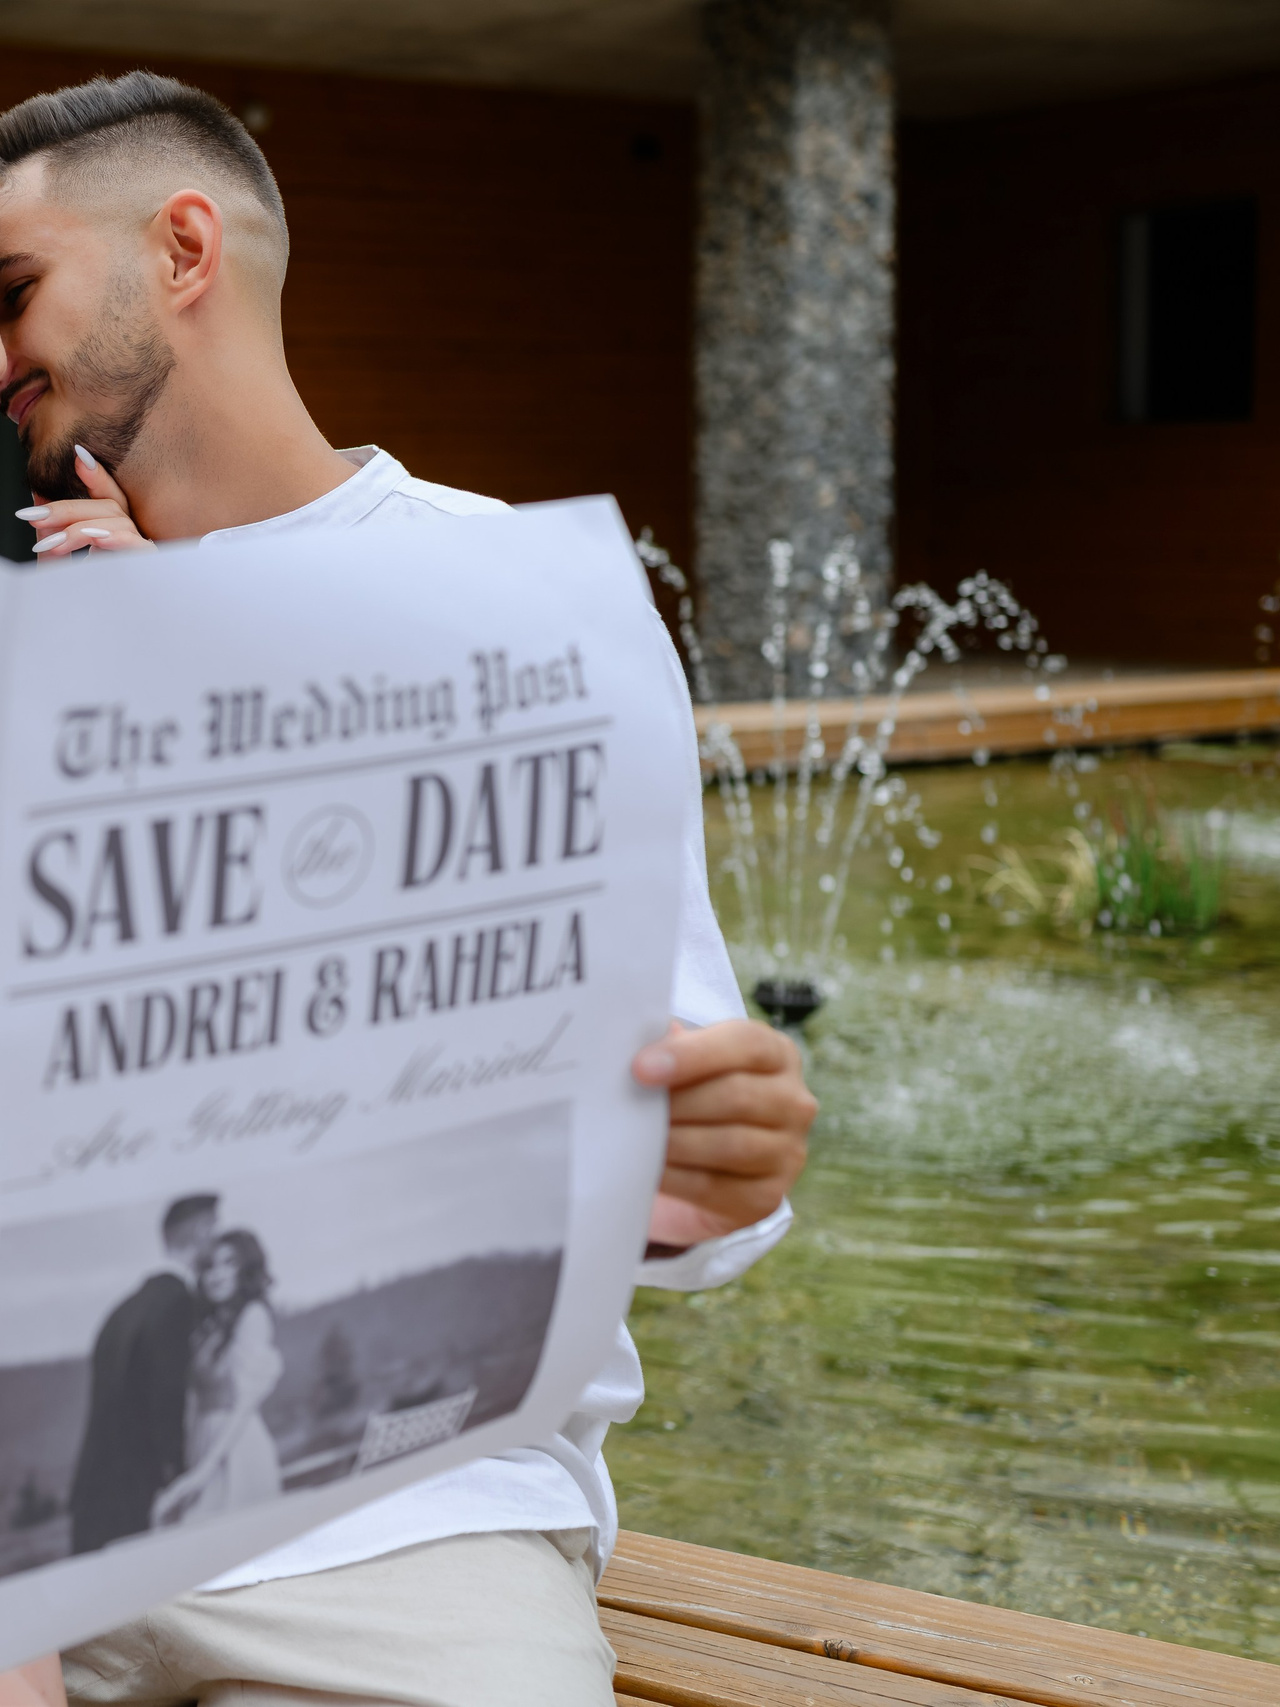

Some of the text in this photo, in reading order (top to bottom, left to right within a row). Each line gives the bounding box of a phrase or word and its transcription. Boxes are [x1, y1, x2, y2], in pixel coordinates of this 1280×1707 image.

[53, 642, 590, 784] The Wedding Post
[21, 741, 608, 961] SAVE the DATE
[43, 909, 588, 1092] ANDREI & RAHELA
[8, 1010, 578, 1188] Are Getting Married
